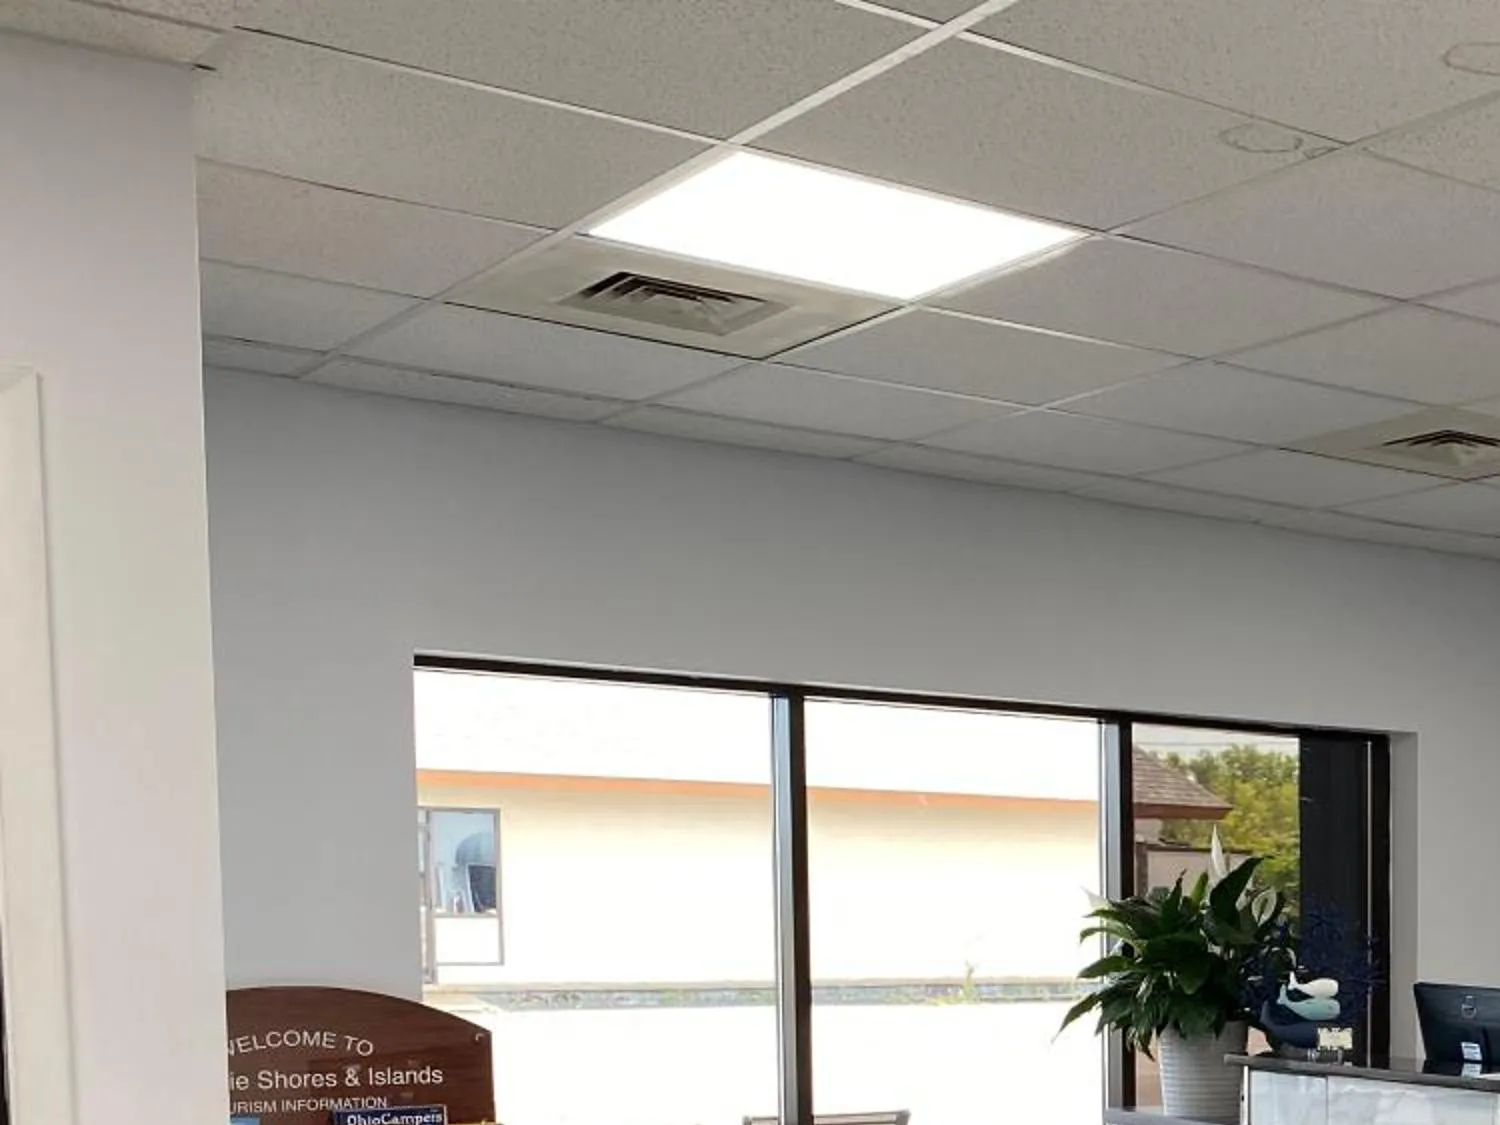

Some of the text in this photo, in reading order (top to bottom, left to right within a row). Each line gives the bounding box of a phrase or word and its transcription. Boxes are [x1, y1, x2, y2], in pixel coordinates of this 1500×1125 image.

[344, 1035, 374, 1057] TO
[230, 1065, 444, 1091] ie Shores & Islands
[230, 1095, 388, 1115] URISM INFORMATION
